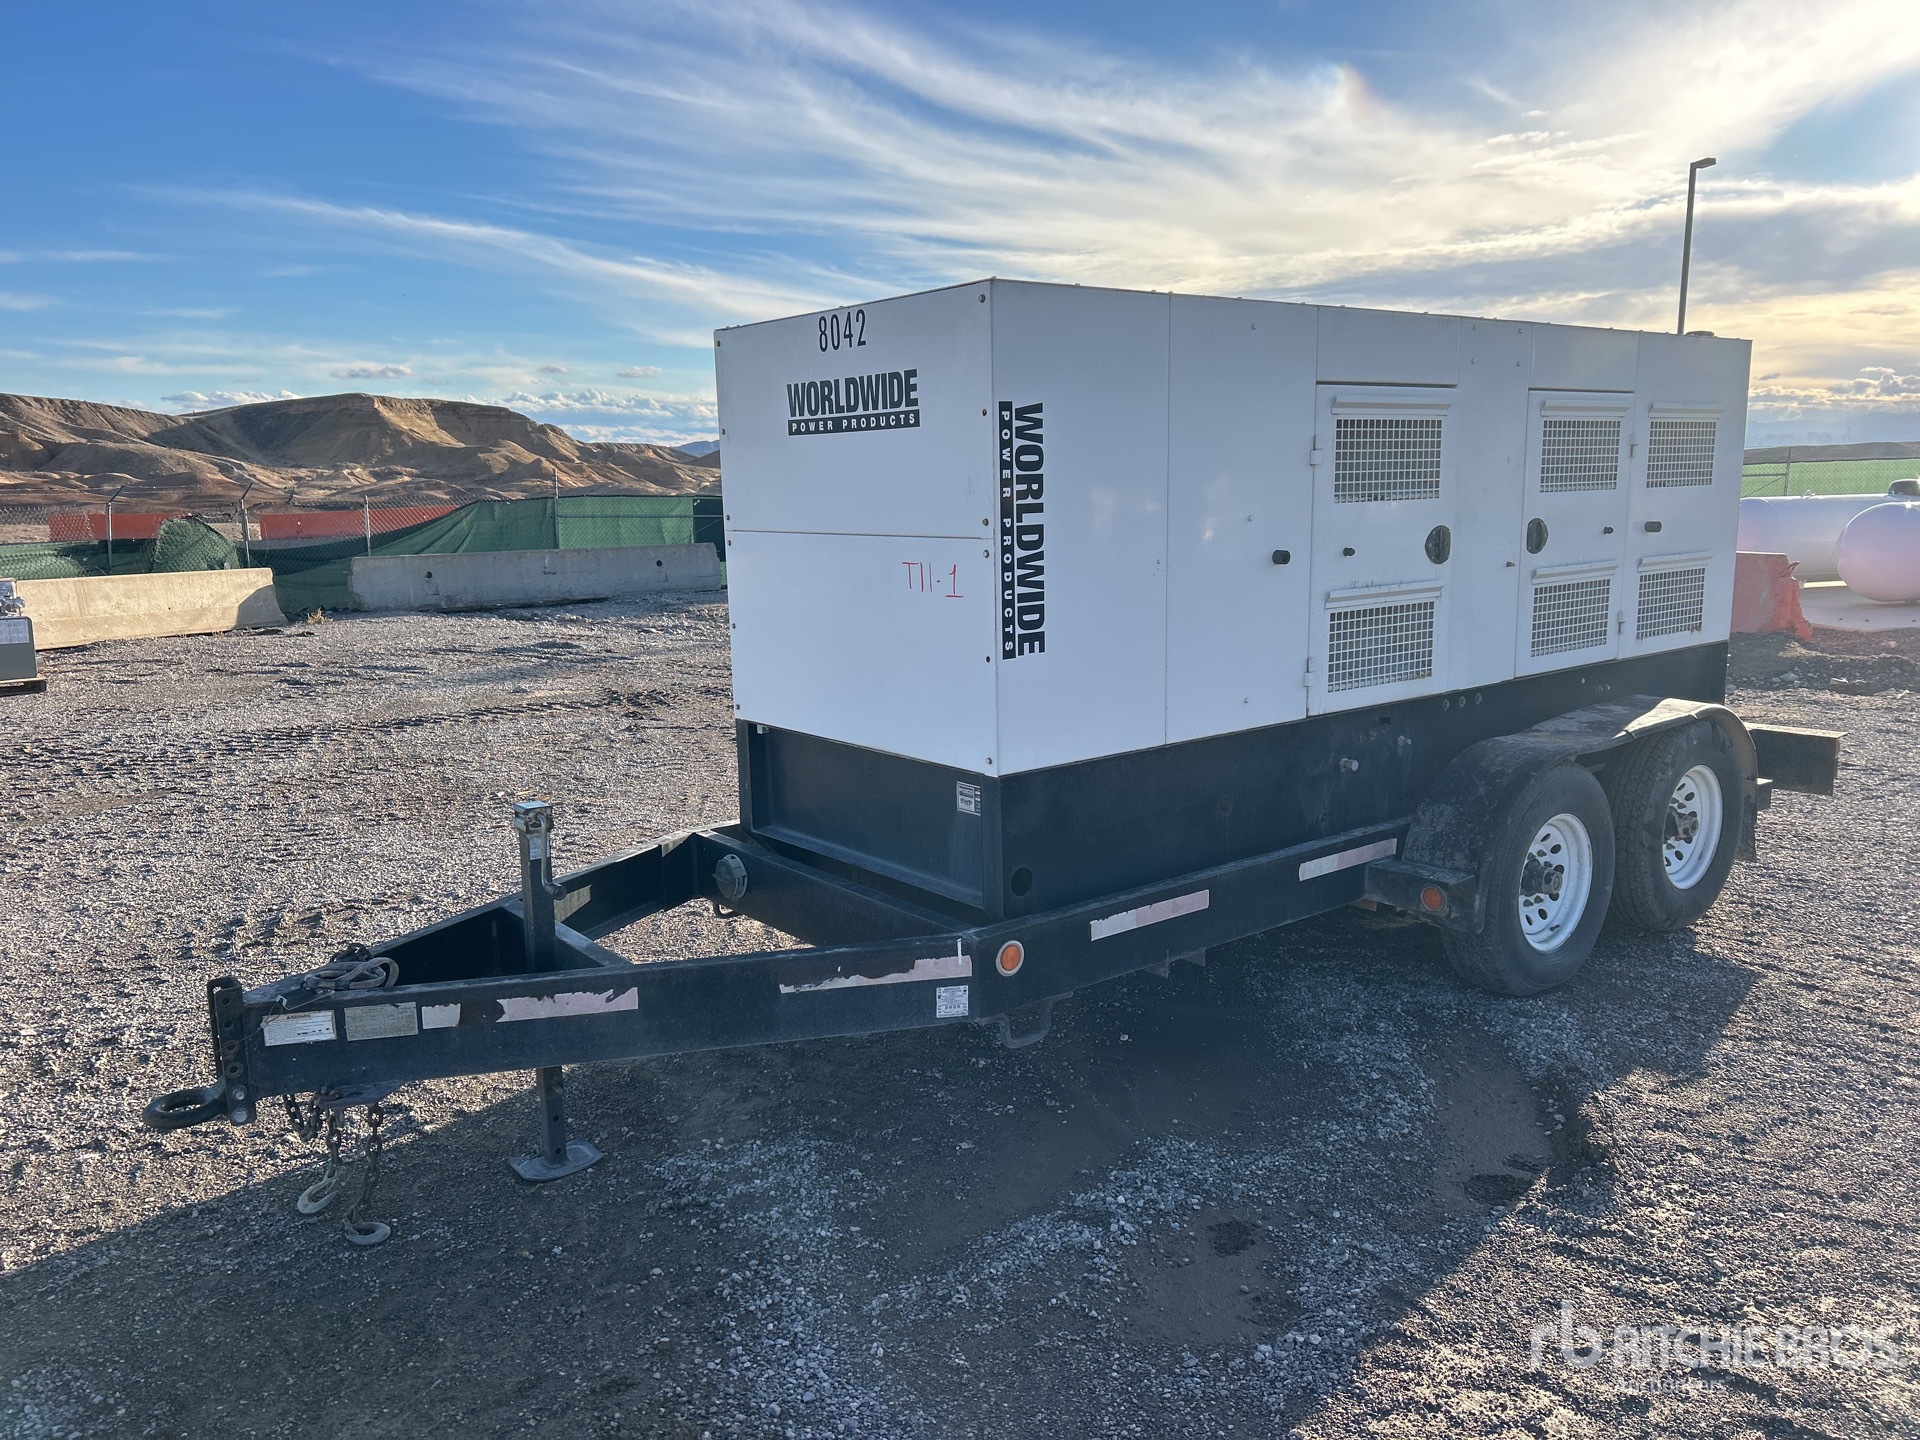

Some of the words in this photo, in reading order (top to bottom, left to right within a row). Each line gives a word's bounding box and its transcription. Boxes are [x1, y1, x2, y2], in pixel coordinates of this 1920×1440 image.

[819, 309, 866, 352] 8042
[786, 368, 919, 418] WORLDWIDE
[792, 421, 833, 432] POWER
[842, 413, 916, 429] PRODUCTS
[1001, 411, 1011, 498] POWER
[1014, 402, 1046, 657] WORLDWIDE
[1003, 518, 1013, 651] PRODUCTS
